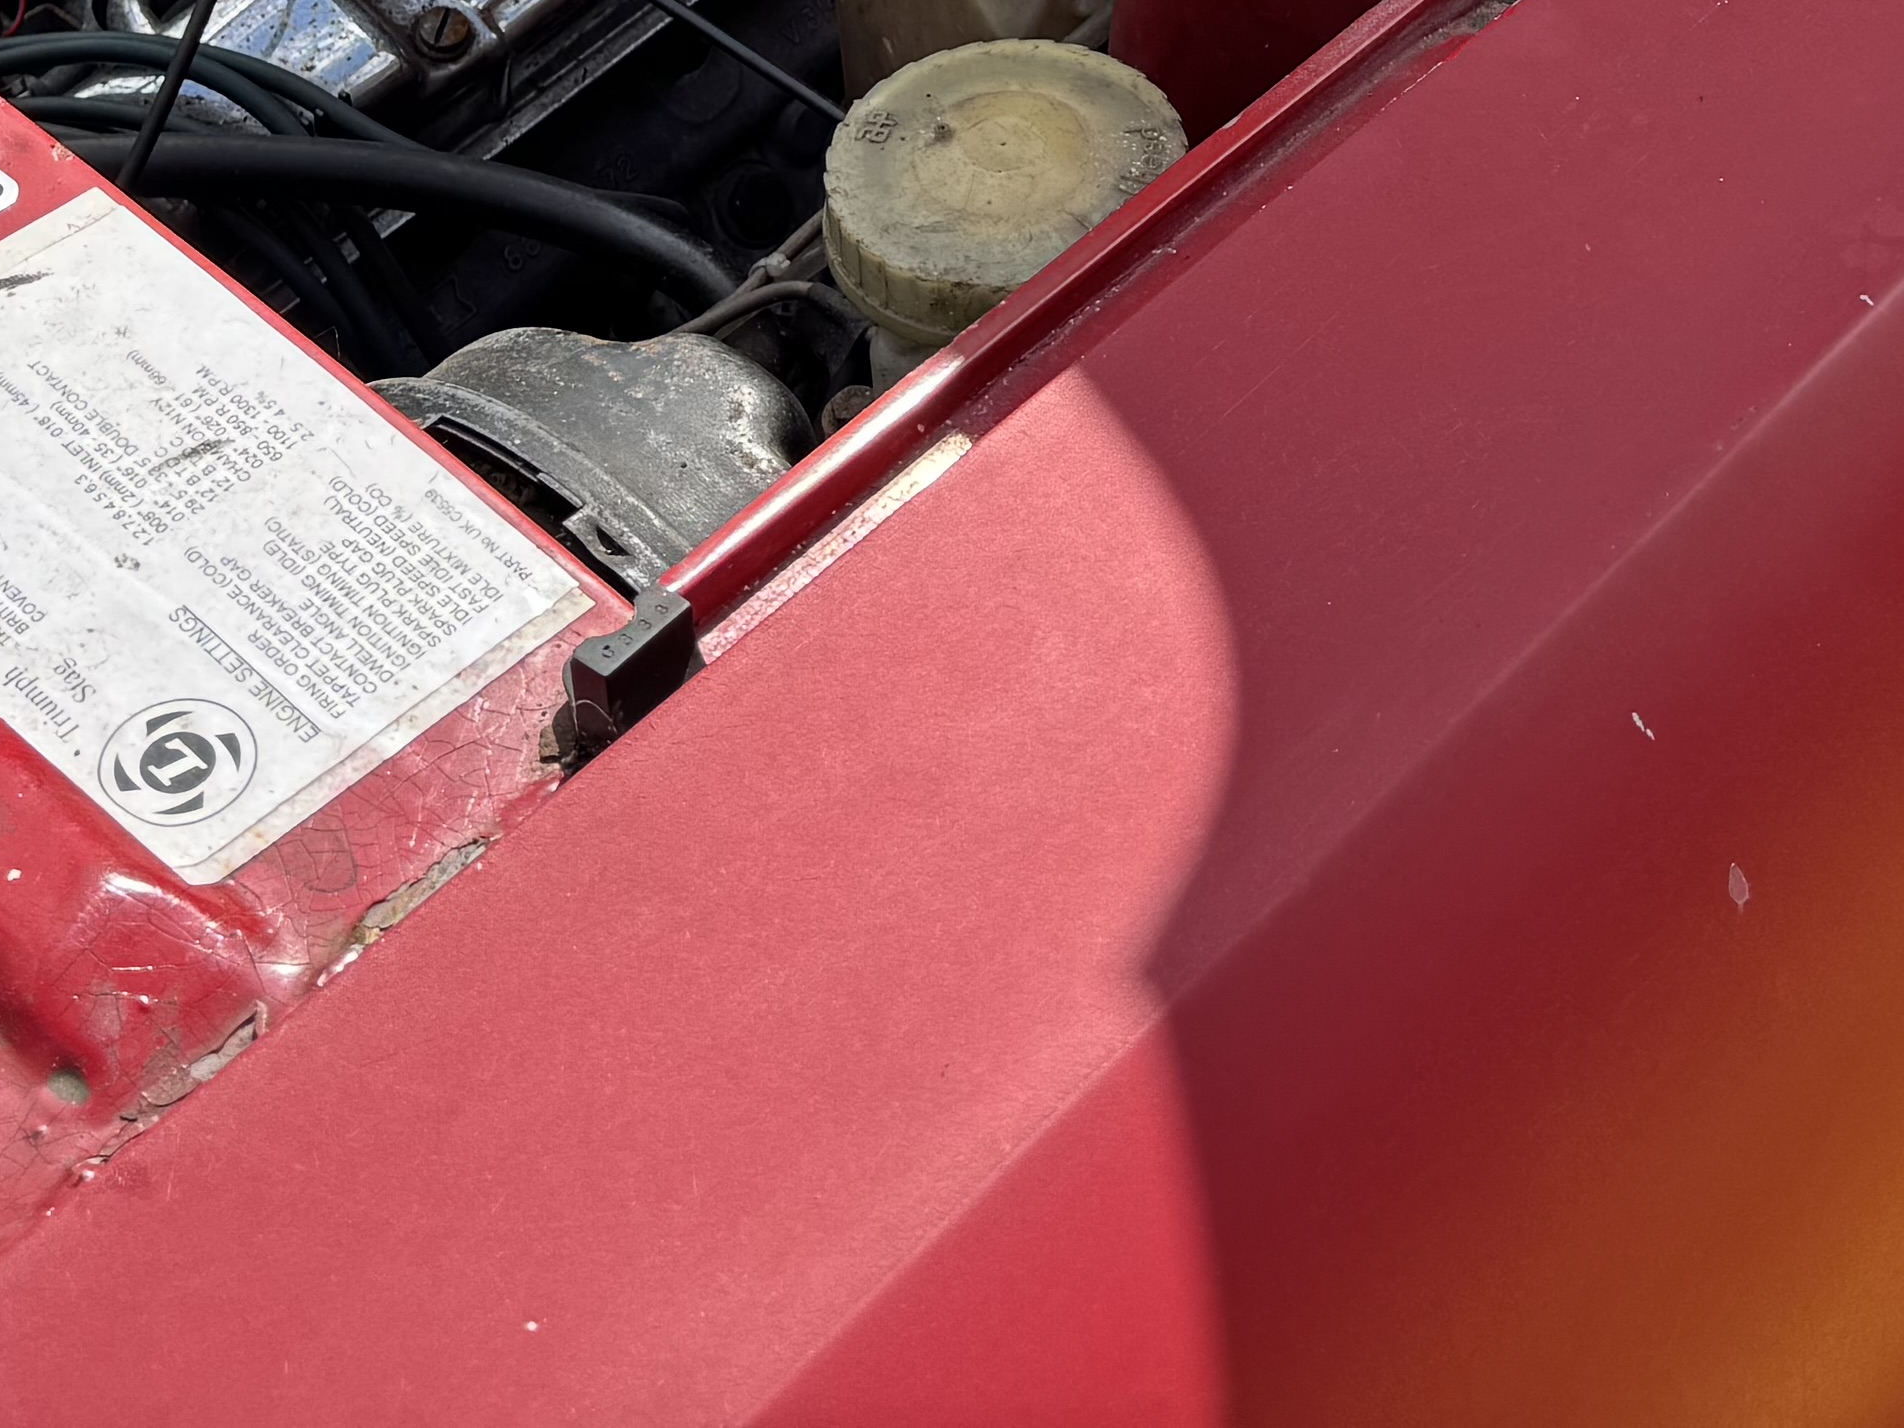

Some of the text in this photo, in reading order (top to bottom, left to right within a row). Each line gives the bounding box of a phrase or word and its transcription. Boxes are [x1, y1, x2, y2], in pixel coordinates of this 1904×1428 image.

[25, 357, 91, 411] CONTACT
[228, 392, 262, 419] 1300
[83, 408, 141, 455] DOUBLE
[179, 421, 253, 483] CHAMPION
[264, 423, 298, 450] 1100
[61, 437, 104, 472] INLET
[325, 473, 379, 516] (COLD)
[362, 481, 395, 508] CO)
[260, 514, 323, 565] (STATIC)
[319, 493, 397, 557] (NEUTRAL)
[370, 512, 424, 556] SPEED
[406, 520, 473, 575] MIXTURE
[460, 520, 484, 538] UK
[179, 543, 236, 589] (COLD)
[216, 552, 254, 582] GAP
[259, 538, 307, 576] (IDLE)
[317, 540, 360, 575] TYPE
[339, 534, 376, 564] GAP
[416, 552, 455, 583] IDLE
[495, 549, 534, 581] PART
[297, 571, 353, 617] TIMING
[313, 560, 369, 606] TIMING
[353, 571, 398, 608] PLUG
[369, 560, 413, 596] PLUG
[388, 553, 443, 598] SPEED
[447, 579, 490, 613] FAST
[466, 571, 505, 602] IDLE
[222, 584, 313, 660] CLEARANCE
[245, 578, 318, 639] BREAKER
[296, 597, 352, 642] ANGLE
[360, 601, 430, 659] IGNITION
[390, 604, 444, 648] SPARK
[405, 592, 459, 637] SPARK
[435, 593, 474, 625] IDLE
[243, 629, 302, 677] ORDER
[341, 636, 397, 682] DWELL
[345, 612, 414, 670] IGNITION
[43, 656, 104, 705] Stag
[163, 604, 323, 742] ENGINE SETTINGS
[302, 655, 364, 706] TAPPET
[309, 634, 382, 694] CONTACT
[293, 672, 350, 719] FIRING
